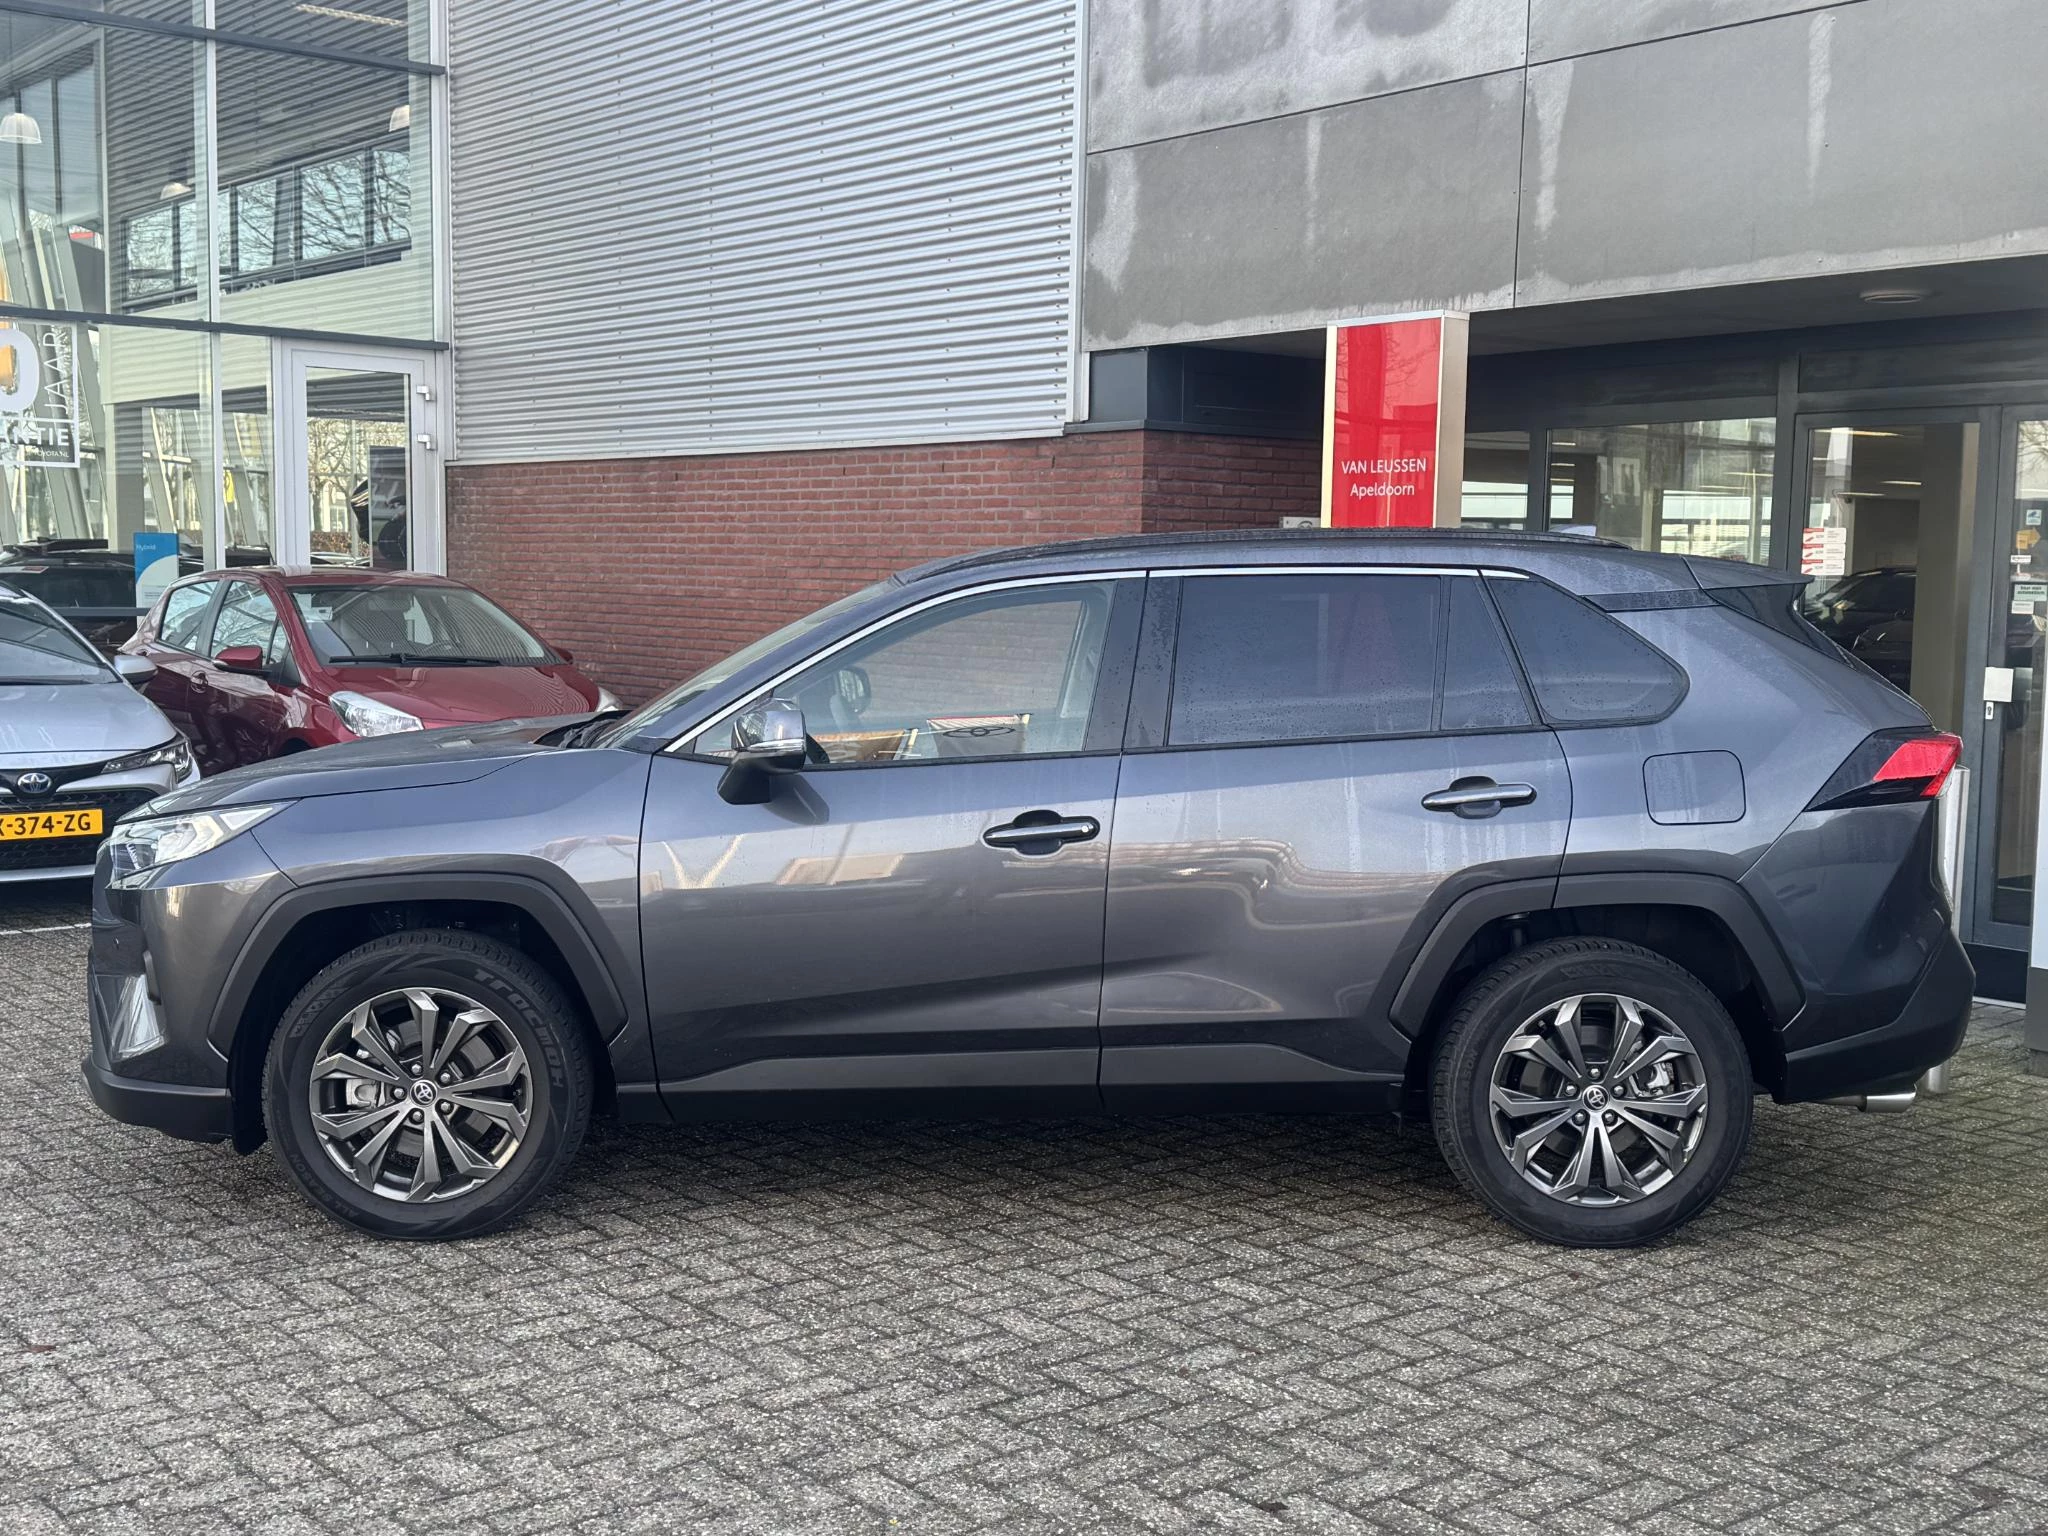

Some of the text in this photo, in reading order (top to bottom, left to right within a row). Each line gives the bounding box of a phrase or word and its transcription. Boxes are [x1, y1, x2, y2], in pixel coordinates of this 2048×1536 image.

[43, 332, 68, 414] JAAR
[1341, 458, 1426, 474] VAN LEUSSEN
[1350, 482, 1415, 500] Apeldoorn
